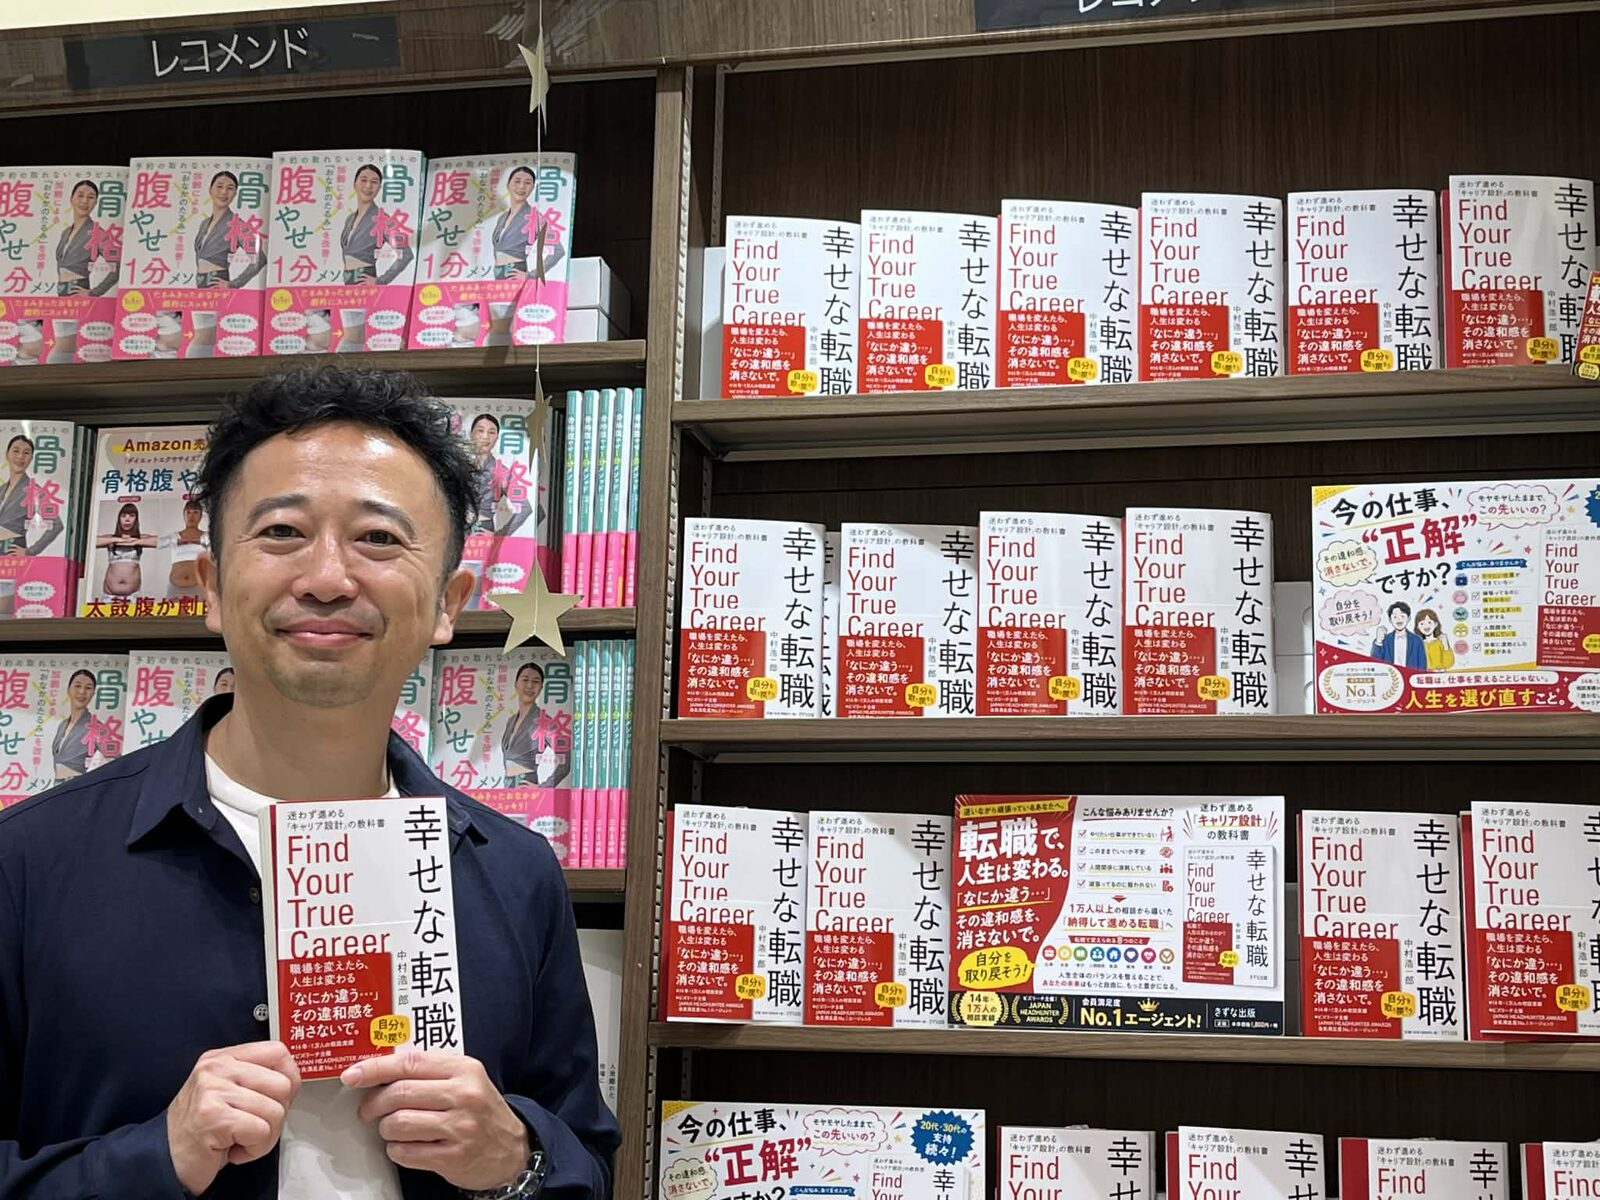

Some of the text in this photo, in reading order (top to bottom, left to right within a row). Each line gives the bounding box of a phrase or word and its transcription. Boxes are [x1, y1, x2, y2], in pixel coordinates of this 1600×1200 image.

[151, 28, 309, 79] レコメンド
[129, 171, 173, 251] 腹やせ
[224, 171, 269, 254] 骨格
[275, 166, 317, 249] 腹やせ
[370, 164, 414, 248] 骨格
[427, 171, 470, 249] 腹やせ
[1297, 215, 1345, 237] Find
[734, 238, 778, 260] Find
[1296, 239, 1348, 260] Your
[733, 261, 781, 282] Your
[1296, 262, 1348, 283] True
[1393, 195, 1432, 370] 幸せな転職
[732, 282, 779, 304] True
[1100, 210, 1132, 383] 幸せな転職
[1243, 202, 1278, 377] 幸せな転職
[1298, 284, 1377, 305] Career
[732, 304, 806, 326] Career
[820, 226, 855, 395] 幸せな転職
[957, 220, 991, 390] 幸せな転職
[21, 435, 66, 520] 骨格
[1331, 488, 1450, 526] 今の仕事、
[848, 547, 894, 568] Find
[1545, 544, 1578, 558] Find
[1545, 560, 1579, 574] Your
[847, 570, 897, 592] Your
[1545, 575, 1579, 589] True
[846, 592, 896, 615] True
[1335, 599, 1360, 610] 自分を
[1544, 590, 1595, 605] Career
[780, 528, 816, 708] 幸せな転職
[938, 530, 974, 714] 幸せな転職
[1082, 521, 1117, 709] 幸せな転職
[1230, 517, 1268, 708] 幸せな転職
[848, 616, 924, 637] Career
[1346, 685, 1376, 698] No.1
[1405, 687, 1565, 710] 人生を選び直すこと。
[438, 664, 478, 754] 腹やせ
[531, 662, 573, 753] 骨格
[287, 809, 344, 820] 迷わず進める
[1200, 804, 1254, 813] 迷わず進める
[287, 819, 385, 830] 「キャリア設計」の教科書
[1207, 830, 1249, 841] の教科書
[287, 834, 349, 864] Find
[958, 816, 1064, 862] 転職で、
[1312, 837, 1363, 862] Find
[286, 866, 354, 896] Your
[957, 857, 1068, 886] 人生は変わる。
[1188, 863, 1214, 878] Find
[1311, 863, 1367, 888] Your
[1188, 879, 1215, 893] Your
[1188, 894, 1215, 908] True
[1246, 850, 1268, 968] 幸せな転職
[1312, 889, 1367, 913] True
[287, 898, 354, 928] True
[767, 817, 803, 1008] 幸せな転職
[908, 820, 945, 1015] 幸せな転職
[956, 908, 1040, 929] その違和感を、
[1187, 909, 1230, 922] Career
[1414, 820, 1458, 1026] 幸せな転職
[404, 804, 458, 1051] 幸せな転職
[1314, 914, 1398, 939] Career
[290, 930, 390, 960] Career
[956, 927, 1040, 949] 消さないで。
[1313, 941, 1380, 952] 職場を変えたら、
[290, 960, 369, 974] 職場を変えたら、
[976, 951, 1012, 967] 自分を
[1313, 952, 1368, 961] 人生は変わる
[290, 973, 356, 988] 人生は変わる
[965, 964, 1027, 983] 取り戻そう!
[1314, 979, 1383, 992] その違和感を
[967, 1004, 997, 1013] 1万人の
[1314, 992, 1372, 1005] 消さないで。
[290, 1004, 373, 1022] その違和感を
[1214, 1007, 1256, 1018] きずな出版
[290, 1022, 361, 1041] 消さないで。
[677, 1108, 787, 1143] 今の仕事、
[933, 1134, 952, 1144] 支持
[1010, 1154, 1059, 1180] Find
[1188, 1154, 1238, 1180] Find
[872, 1172, 902, 1189] Find
[1378, 1168, 1426, 1194] Find
